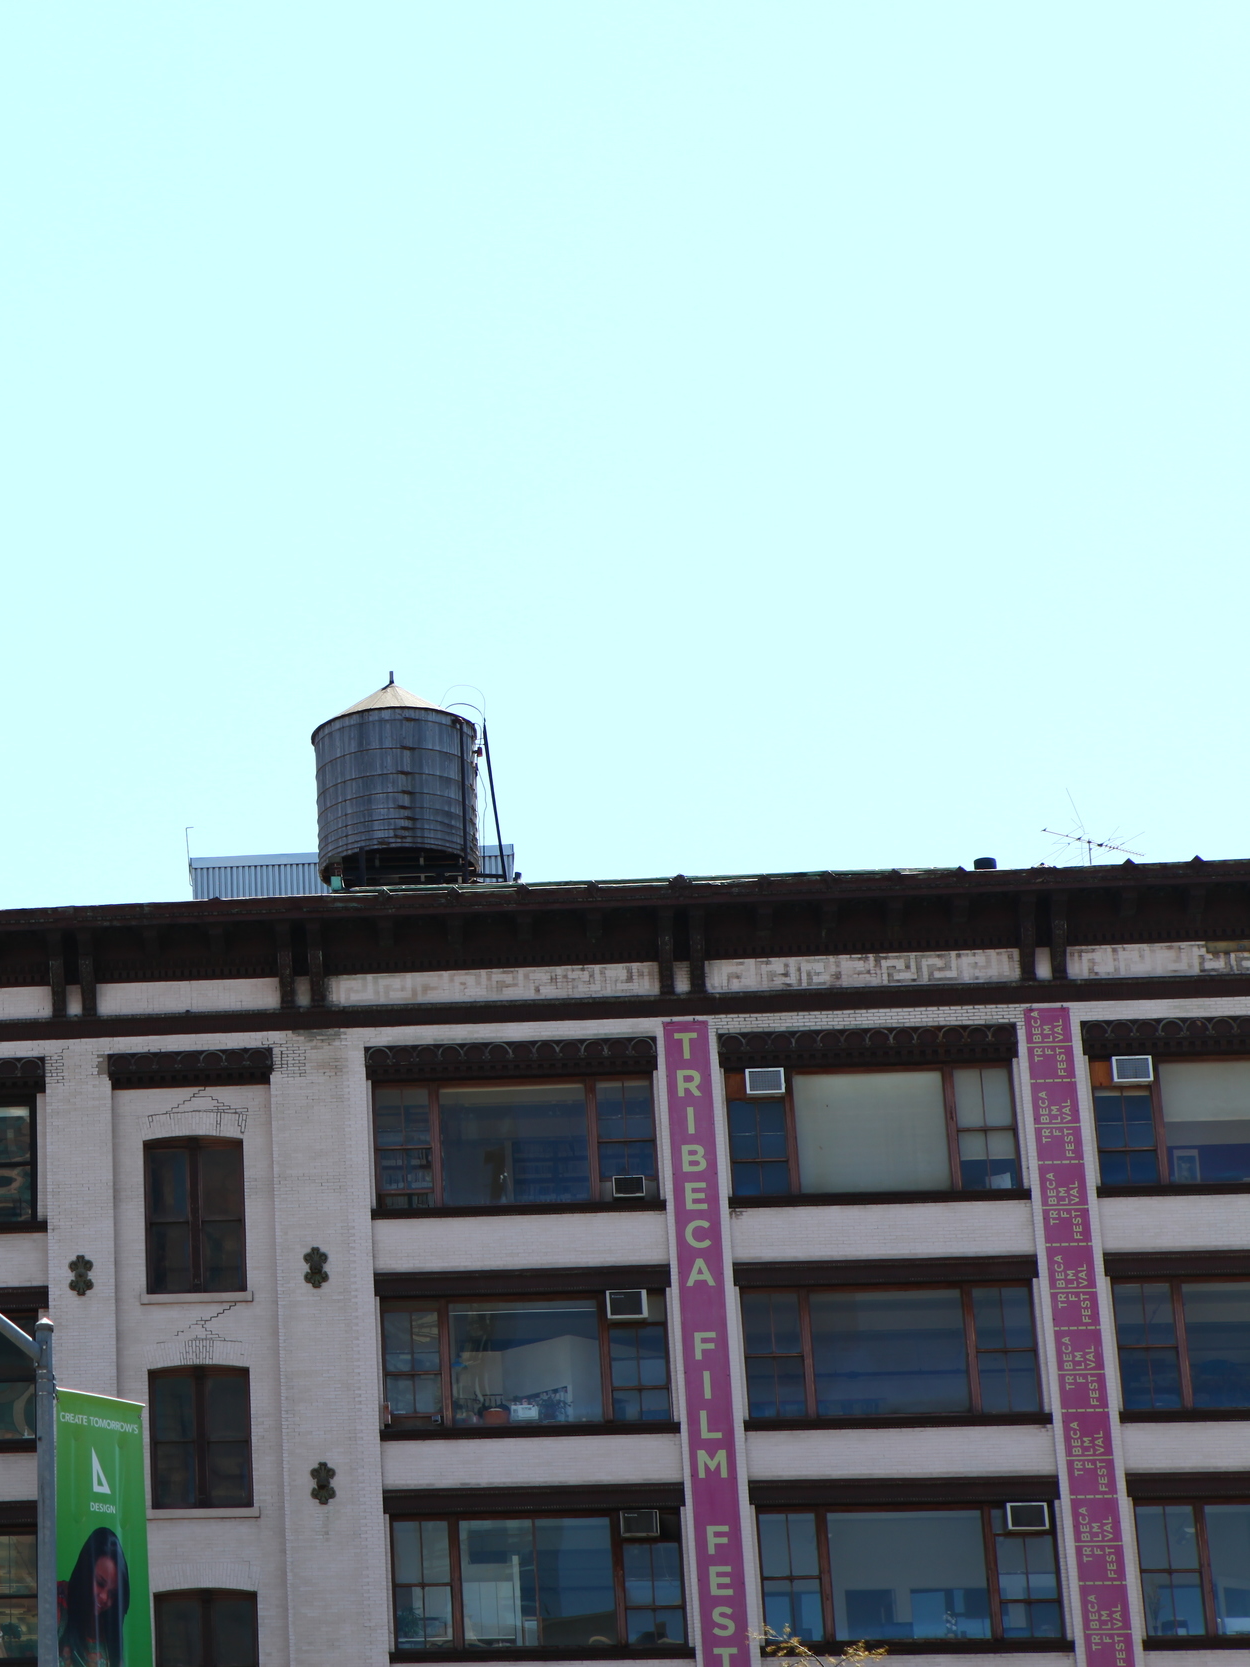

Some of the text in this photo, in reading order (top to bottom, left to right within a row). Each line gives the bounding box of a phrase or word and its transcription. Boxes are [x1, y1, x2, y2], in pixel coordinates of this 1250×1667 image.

[674, 1032, 716, 1286] TRIBECA
[60, 1412, 138, 1434] CREATE TOMORROW'S
[694, 1332, 728, 1478] FILM
[90, 1502, 116, 1514] DESIGN
